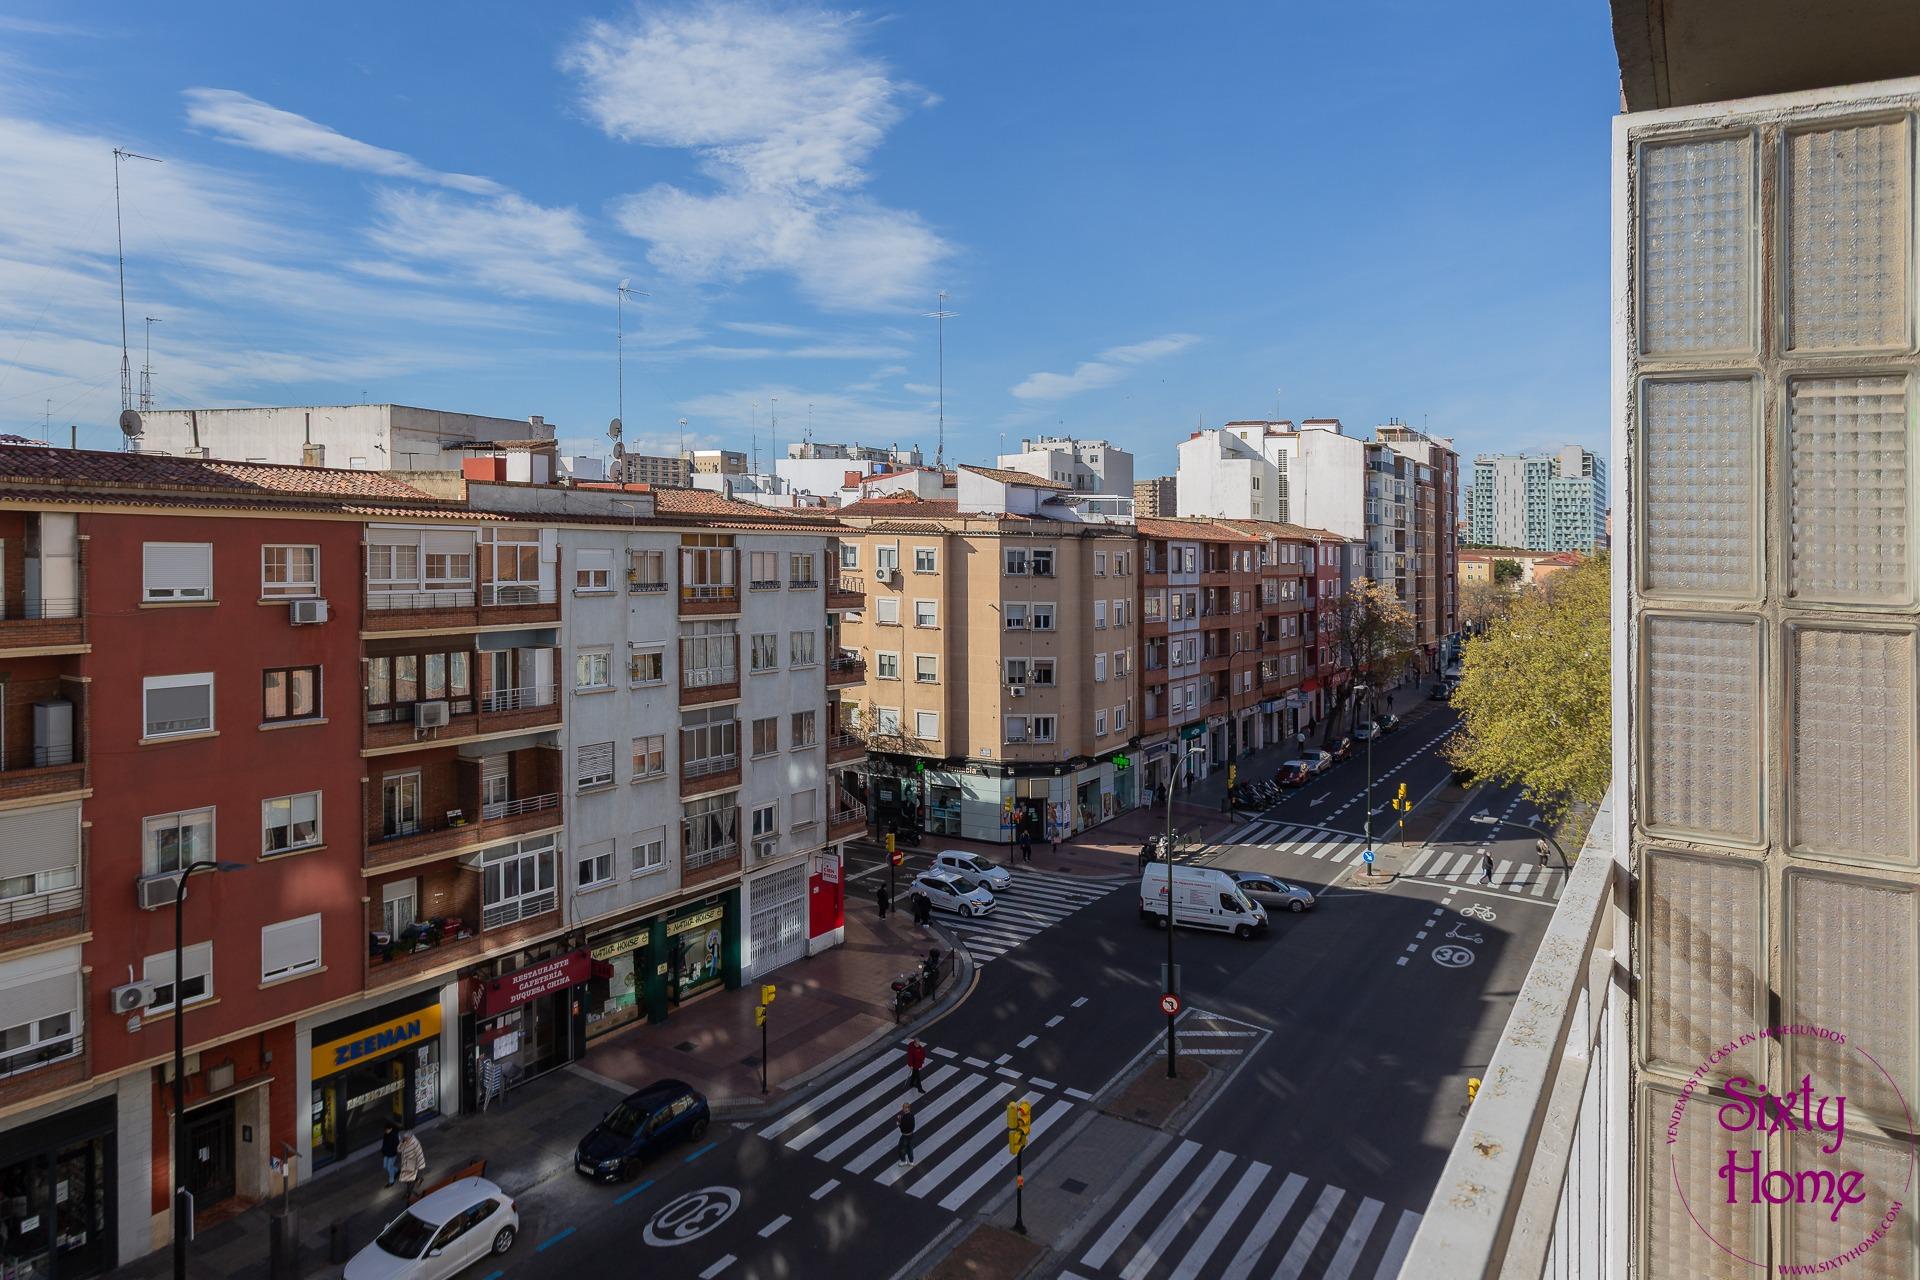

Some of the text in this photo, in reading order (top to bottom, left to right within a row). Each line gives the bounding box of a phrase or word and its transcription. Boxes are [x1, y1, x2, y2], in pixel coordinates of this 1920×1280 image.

[694, 910, 715, 924] HOUSE
[437, 948, 470, 964] 30
[616, 936, 640, 951] HOUSE
[512, 959, 569, 985] RESTAURANTE
[510, 976, 570, 1003] DUQUESA CHINA
[335, 1020, 420, 1066] ZEEMAN
[657, 1194, 729, 1238] 30
